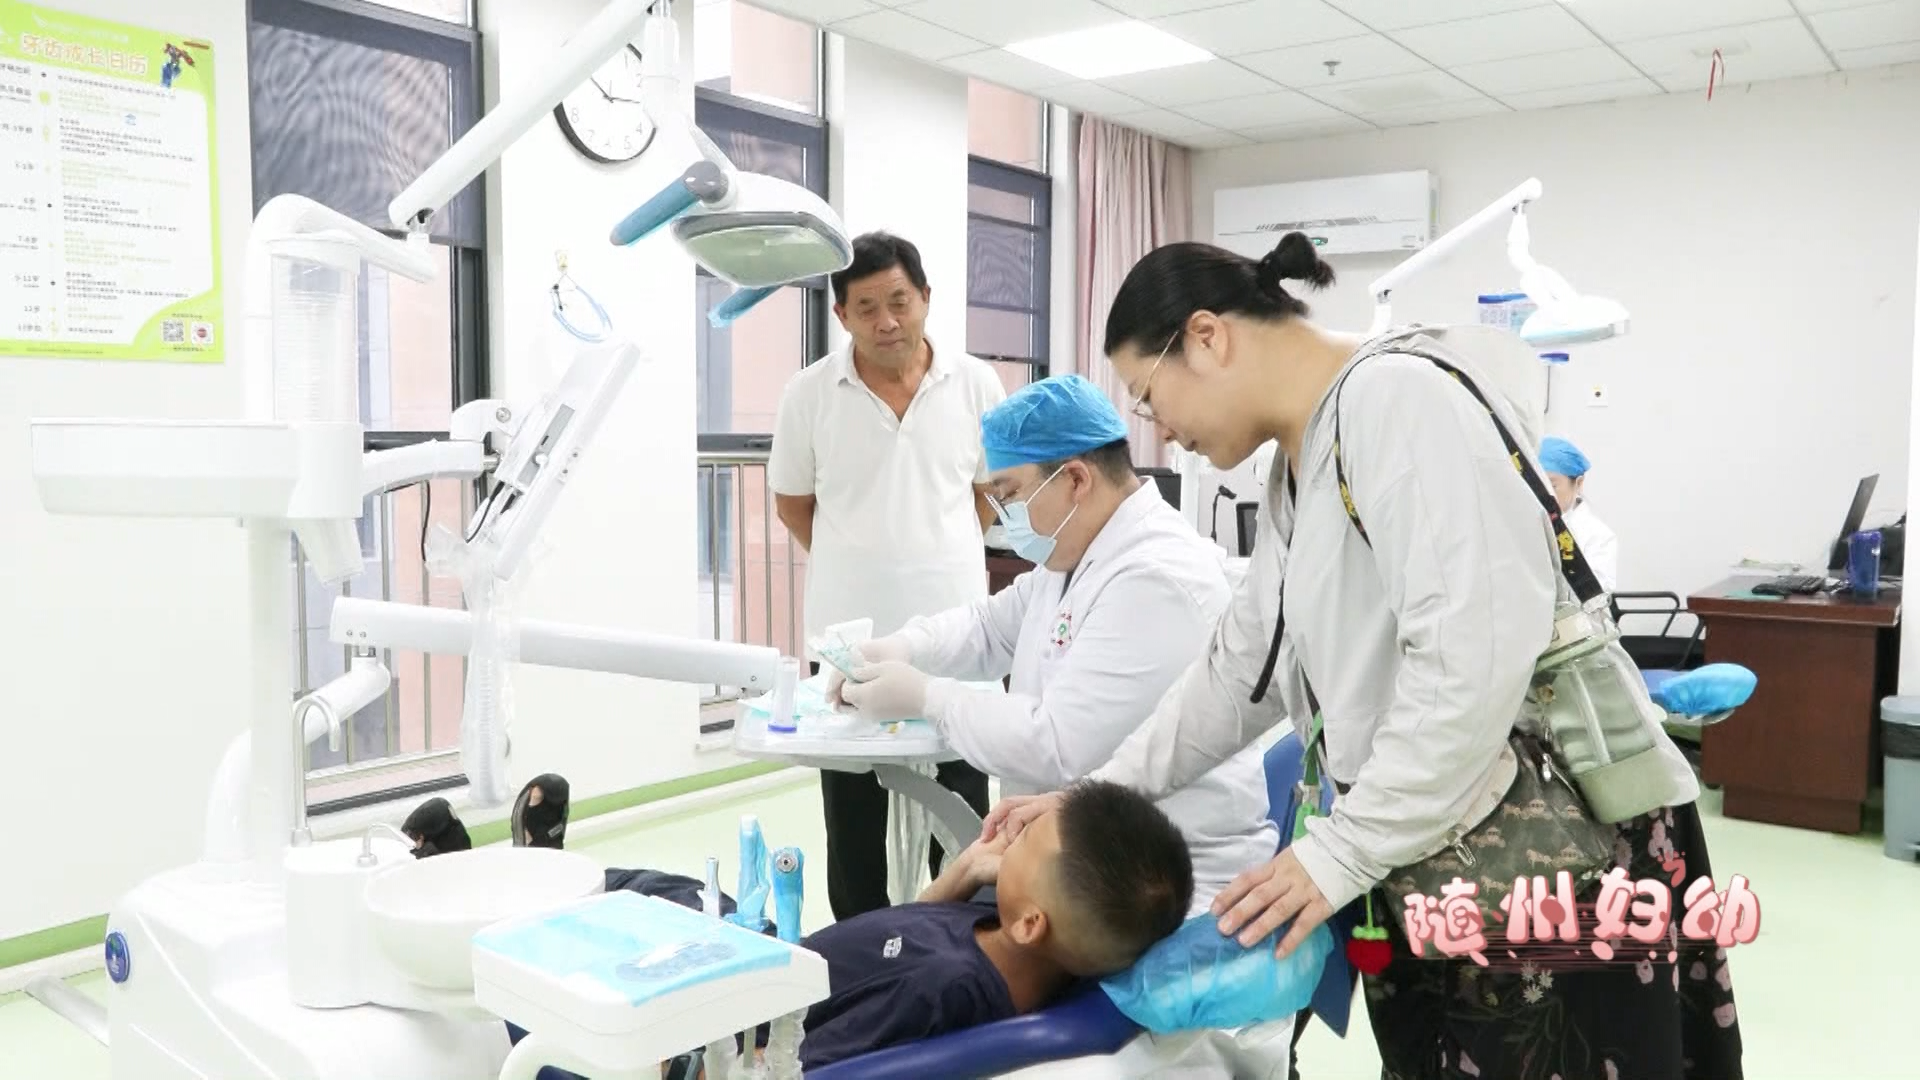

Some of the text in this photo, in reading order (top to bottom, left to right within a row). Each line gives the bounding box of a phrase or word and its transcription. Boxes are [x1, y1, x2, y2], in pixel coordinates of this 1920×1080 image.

[22, 32, 148, 76] 牙齿成长日历
